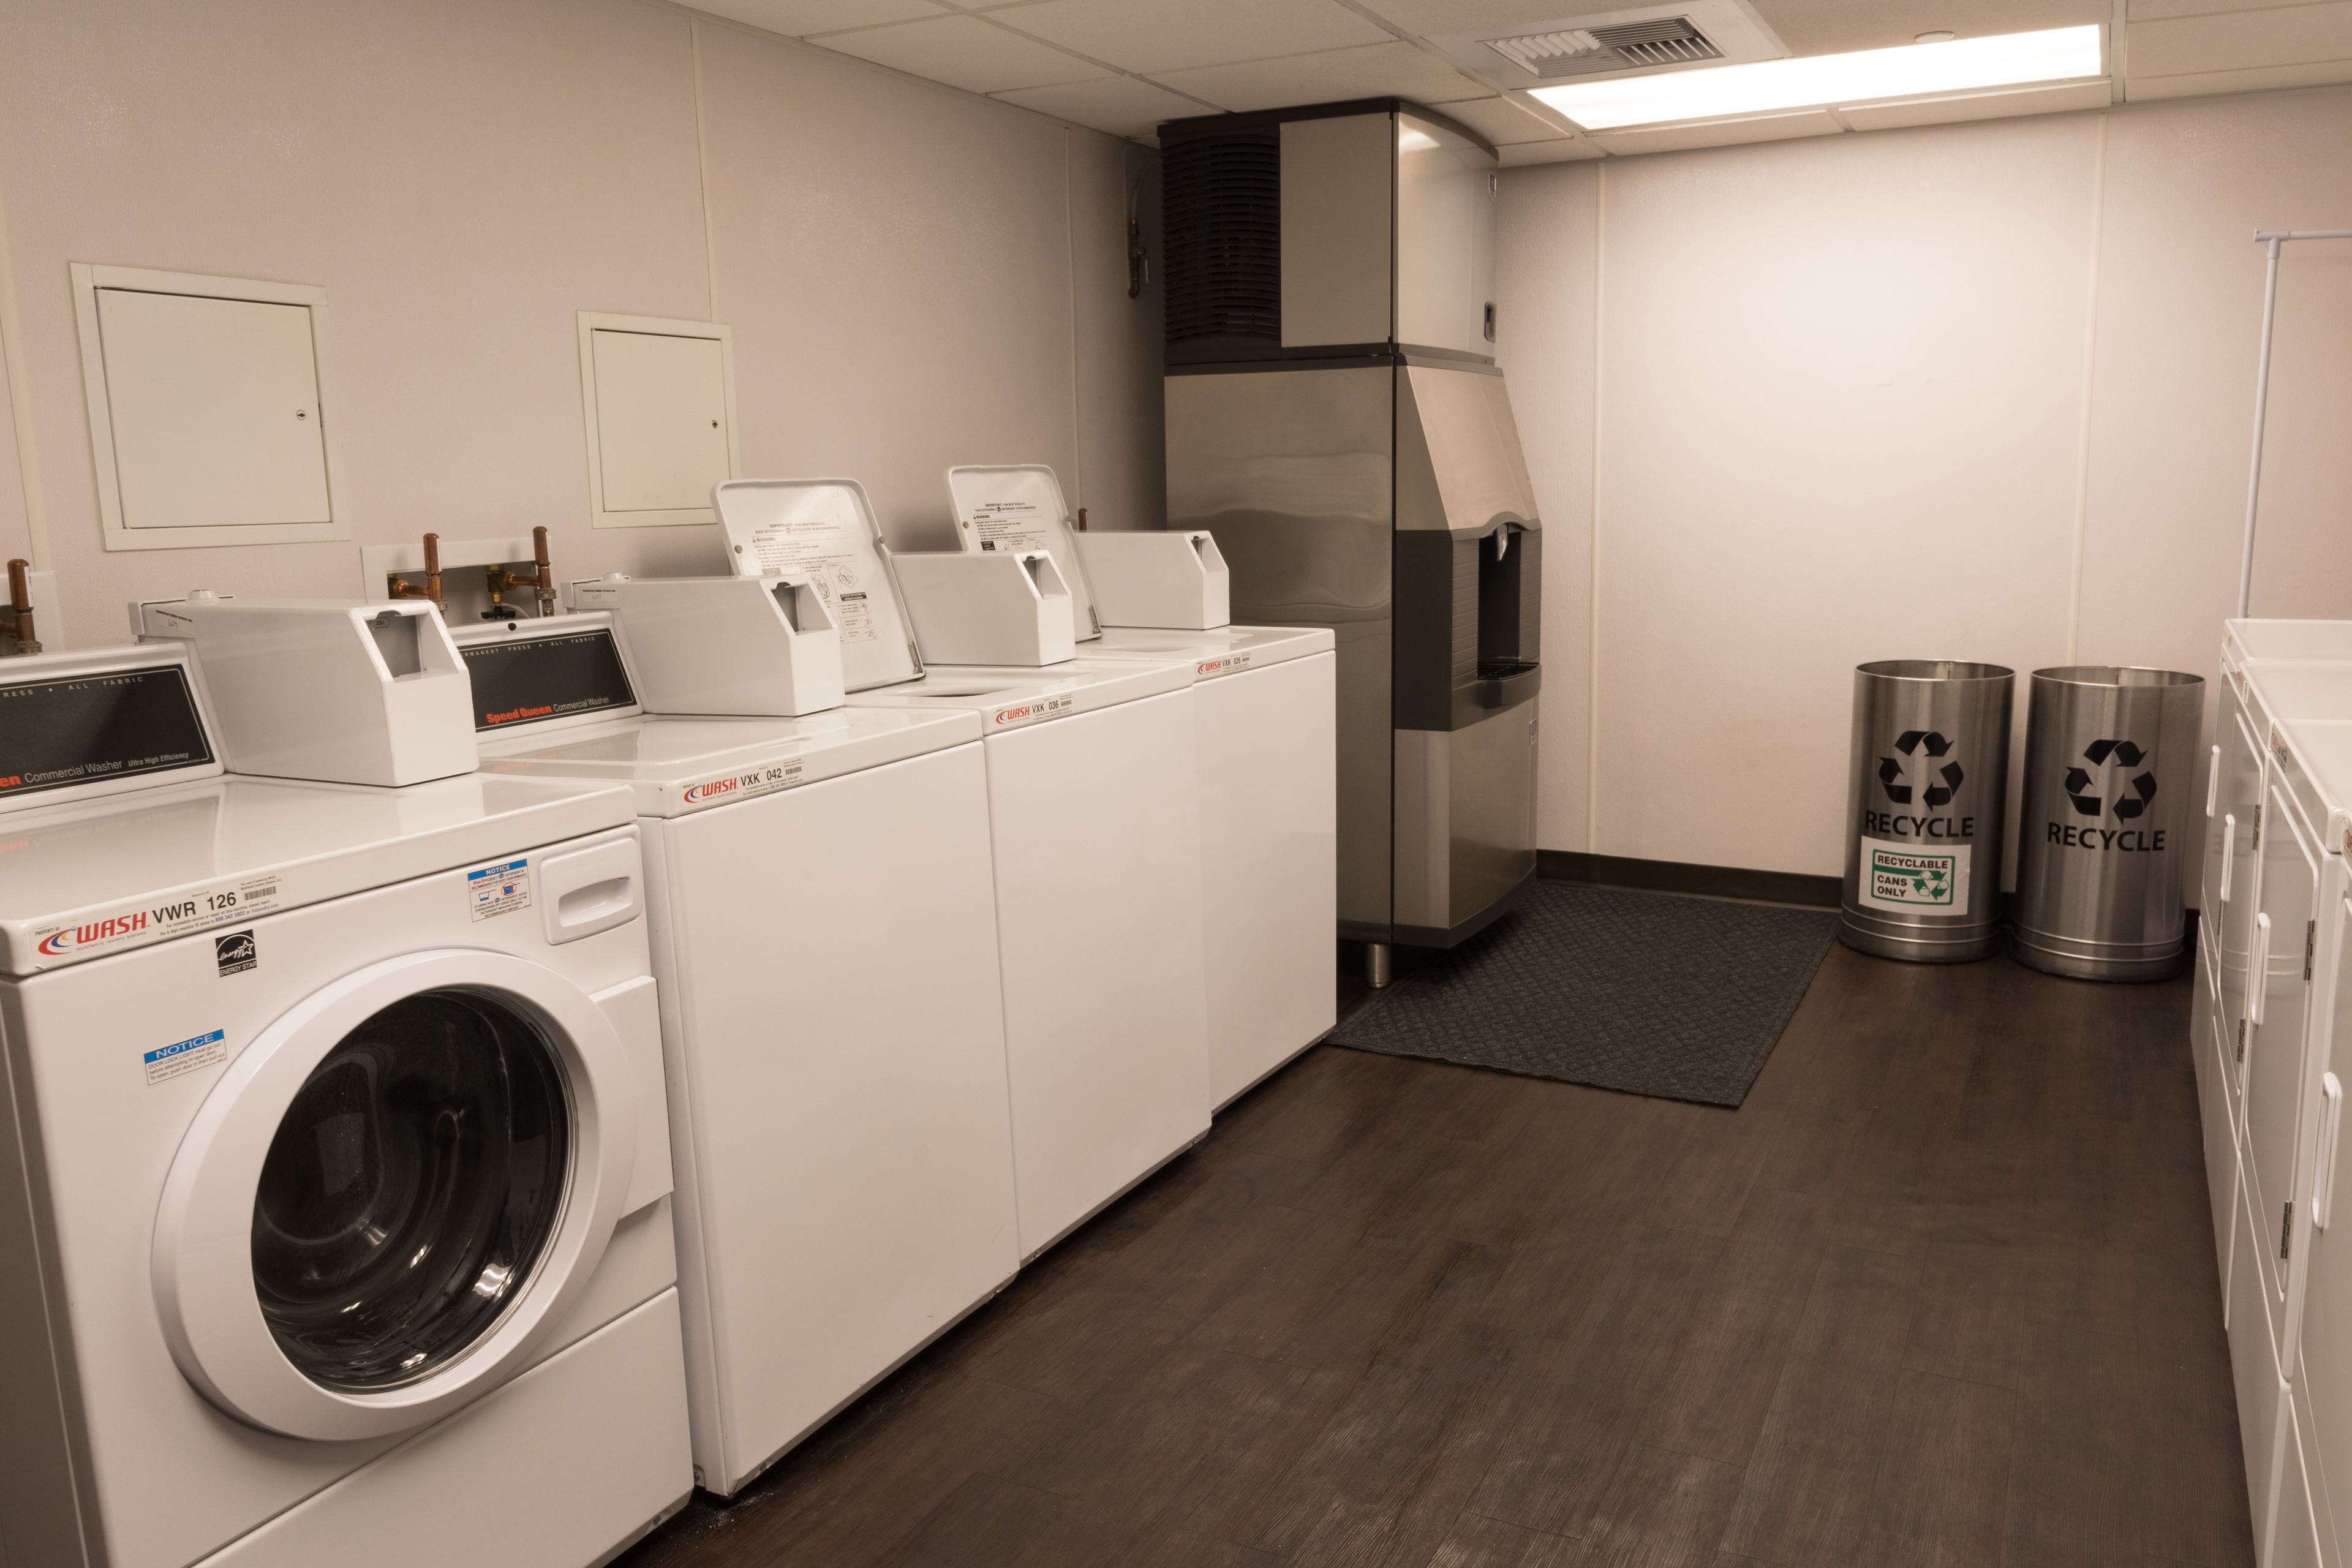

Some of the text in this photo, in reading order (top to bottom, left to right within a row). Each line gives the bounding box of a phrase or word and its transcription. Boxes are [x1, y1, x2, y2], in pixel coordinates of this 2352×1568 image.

[461, 649, 500, 658] ERMANENT
[1205, 661, 1221, 671] WASH
[4, 676, 144, 698] RESS ALL FABRIC
[486, 696, 609, 724] Speed Queen Commercial Washer
[1008, 706, 1030, 720] WASH
[1032, 703, 1045, 714] VXK
[1049, 701, 1058, 710] 036
[24, 764, 86, 784] Commercial
[85, 760, 123, 774] Washer
[128, 758, 143, 767] Ultra
[145, 756, 159, 765] High
[160, 752, 189, 763] Efficiency
[702, 777, 737, 797] WASH
[741, 772, 760, 786] VXK
[767, 768, 782, 781] 042
[1865, 810, 1974, 838] RECYCLE
[2047, 821, 2166, 852] RECYCLE
[486, 864, 510, 875] NOTICE
[1877, 855, 1948, 869] RECYCLABLE
[1877, 875, 1907, 886] CANS
[1877, 886, 1907, 897] ONLY
[152, 892, 236, 924] VWR 126
[36, 927, 54, 936] PROPERTY
[77, 911, 146, 944] WASH
[77, 941, 104, 951] multifamily
[221, 961, 257, 976] ENERGY STAR
[156, 1033, 214, 1059] NOTICE
[148, 1061, 164, 1069] DOOR
[179, 1051, 194, 1060] LIGHT
[165, 1059, 188, 1070] attempting
